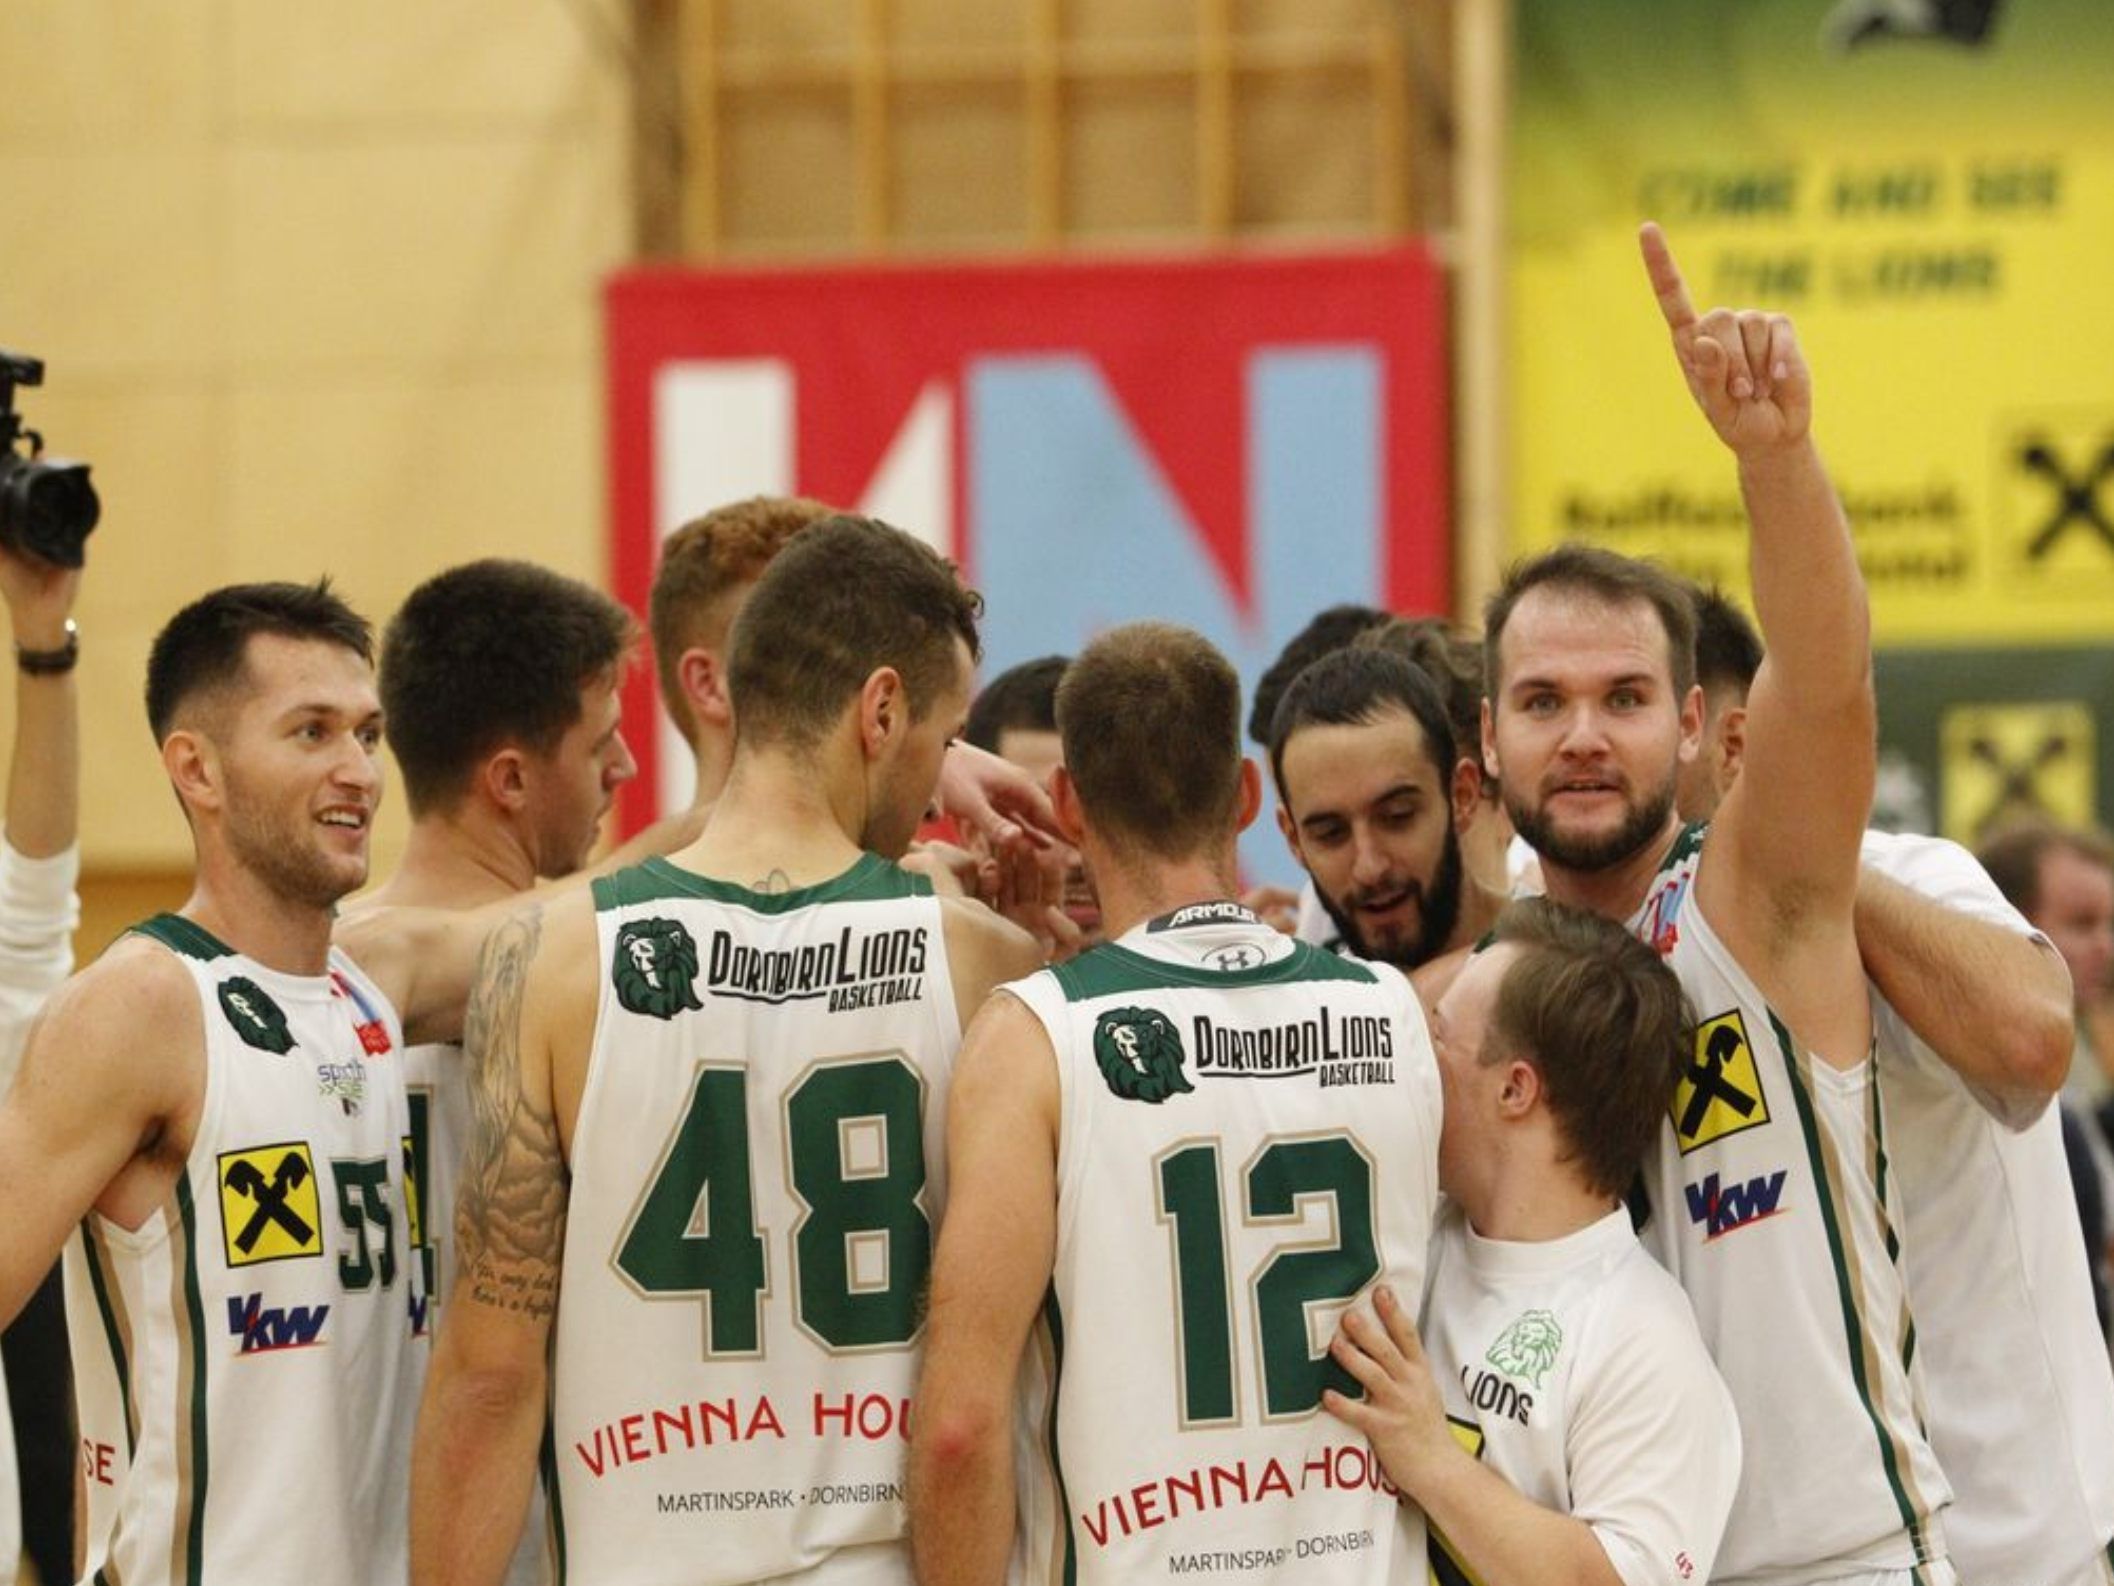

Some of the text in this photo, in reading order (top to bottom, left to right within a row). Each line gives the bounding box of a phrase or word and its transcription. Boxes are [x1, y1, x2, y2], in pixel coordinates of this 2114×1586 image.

[828, 976, 922, 1014] BASKETBALL
[1319, 1061, 1395, 1087] BASKETBALL
[329, 1157, 397, 1293] 55
[608, 1048, 938, 1362] 48
[1150, 1127, 1384, 1432] 12
[576, 1395, 785, 1478] VIENNA
[657, 1489, 794, 1513] MARTINSPARK
[1082, 1457, 1294, 1547] VIENNA
